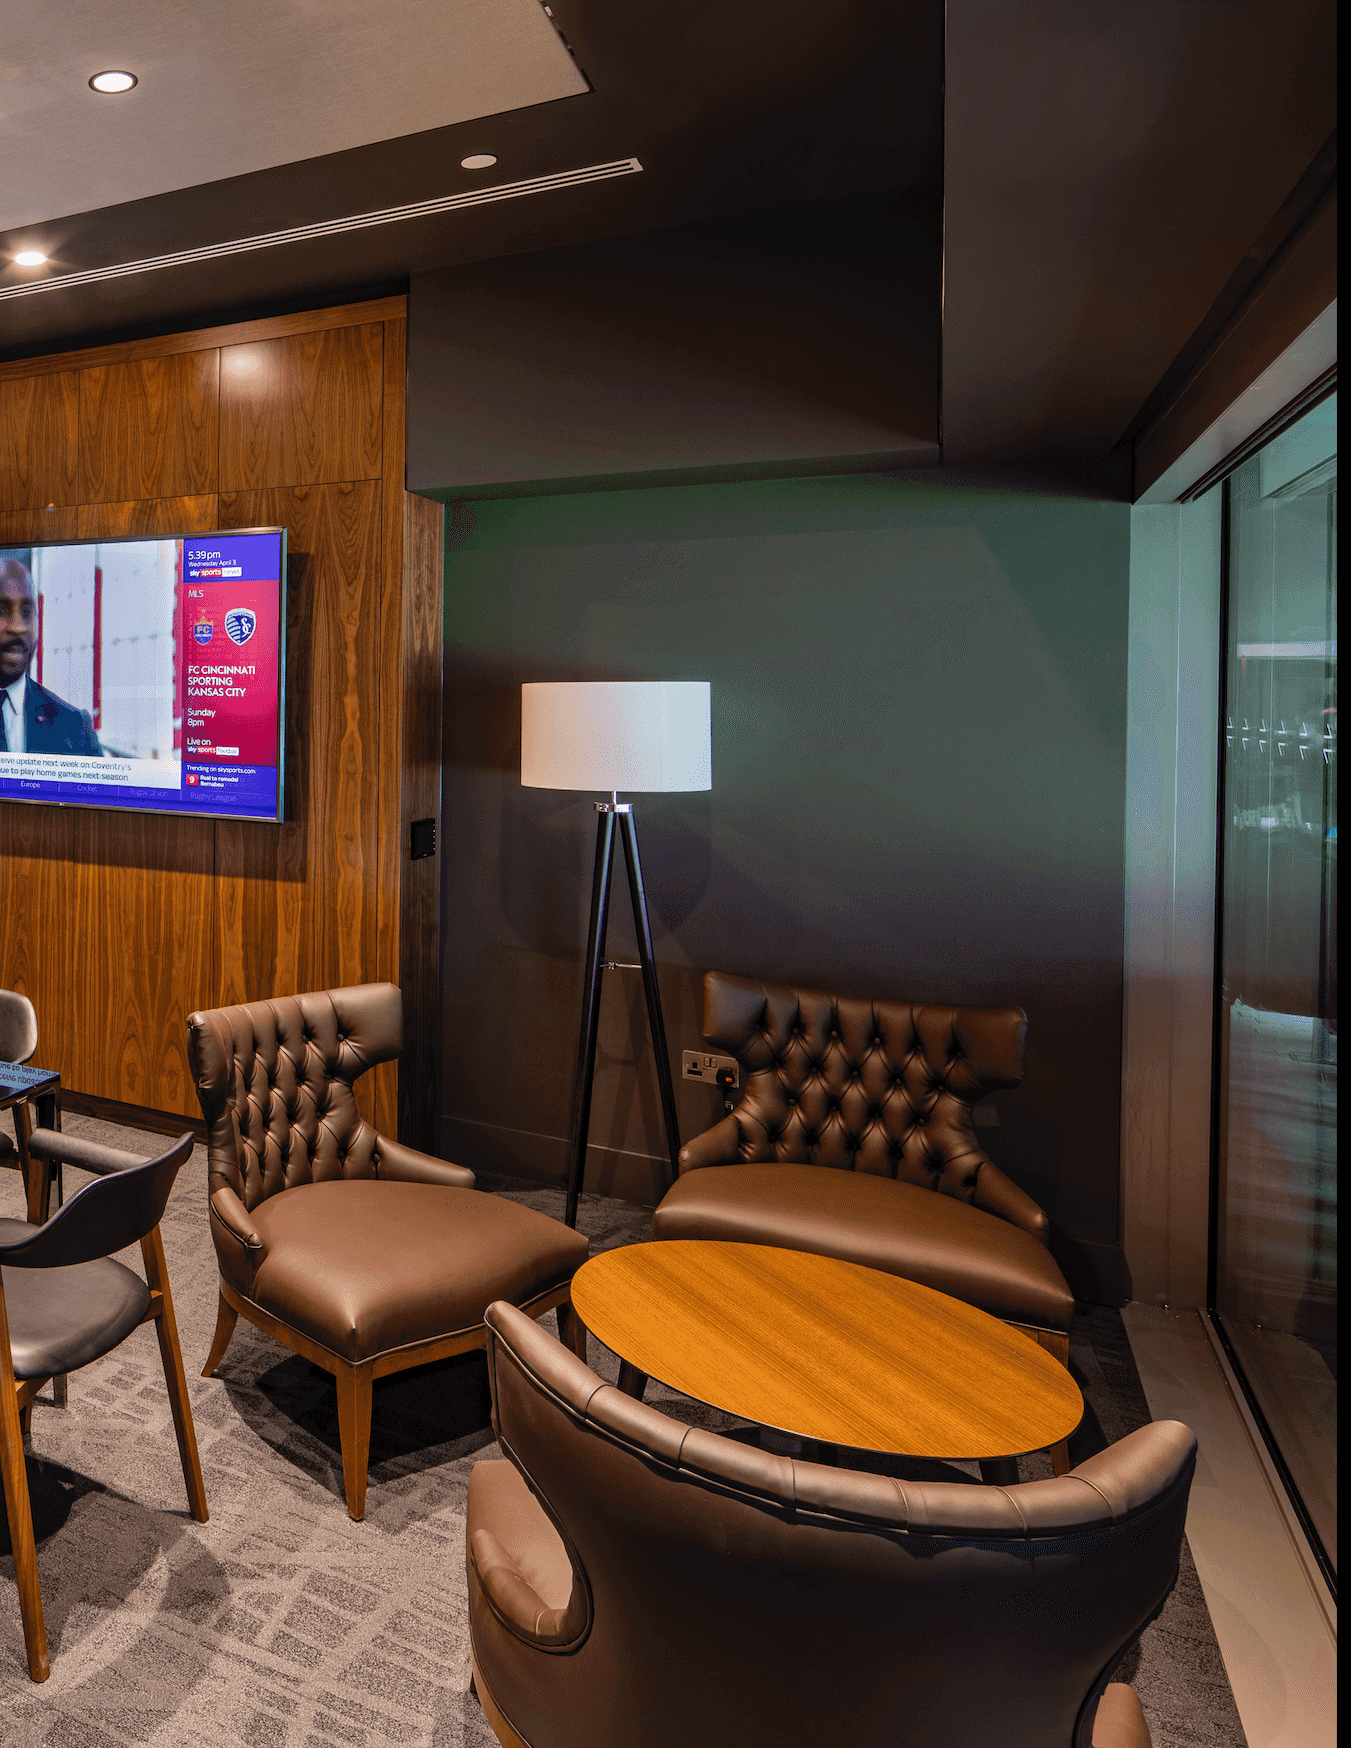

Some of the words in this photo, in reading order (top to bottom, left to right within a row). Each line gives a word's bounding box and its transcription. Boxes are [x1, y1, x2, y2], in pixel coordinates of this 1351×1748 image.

[188, 551, 221, 560] 5.39pm
[188, 590, 204, 598] MLS
[188, 666, 199, 674] FC
[201, 666, 255, 674] CINCINNATI
[188, 677, 233, 686] SPORTING
[188, 687, 224, 696] KANSAS
[225, 688, 246, 697] CITY
[188, 708, 216, 718] Sunday
[188, 718, 204, 727] 8pm
[16, 758, 41, 766] update
[91, 762, 131, 771] Coventry's
[187, 765, 209, 773] Trending
[20, 768, 34, 777] play
[58, 771, 81, 779] games
[21, 781, 41, 789] Europe
